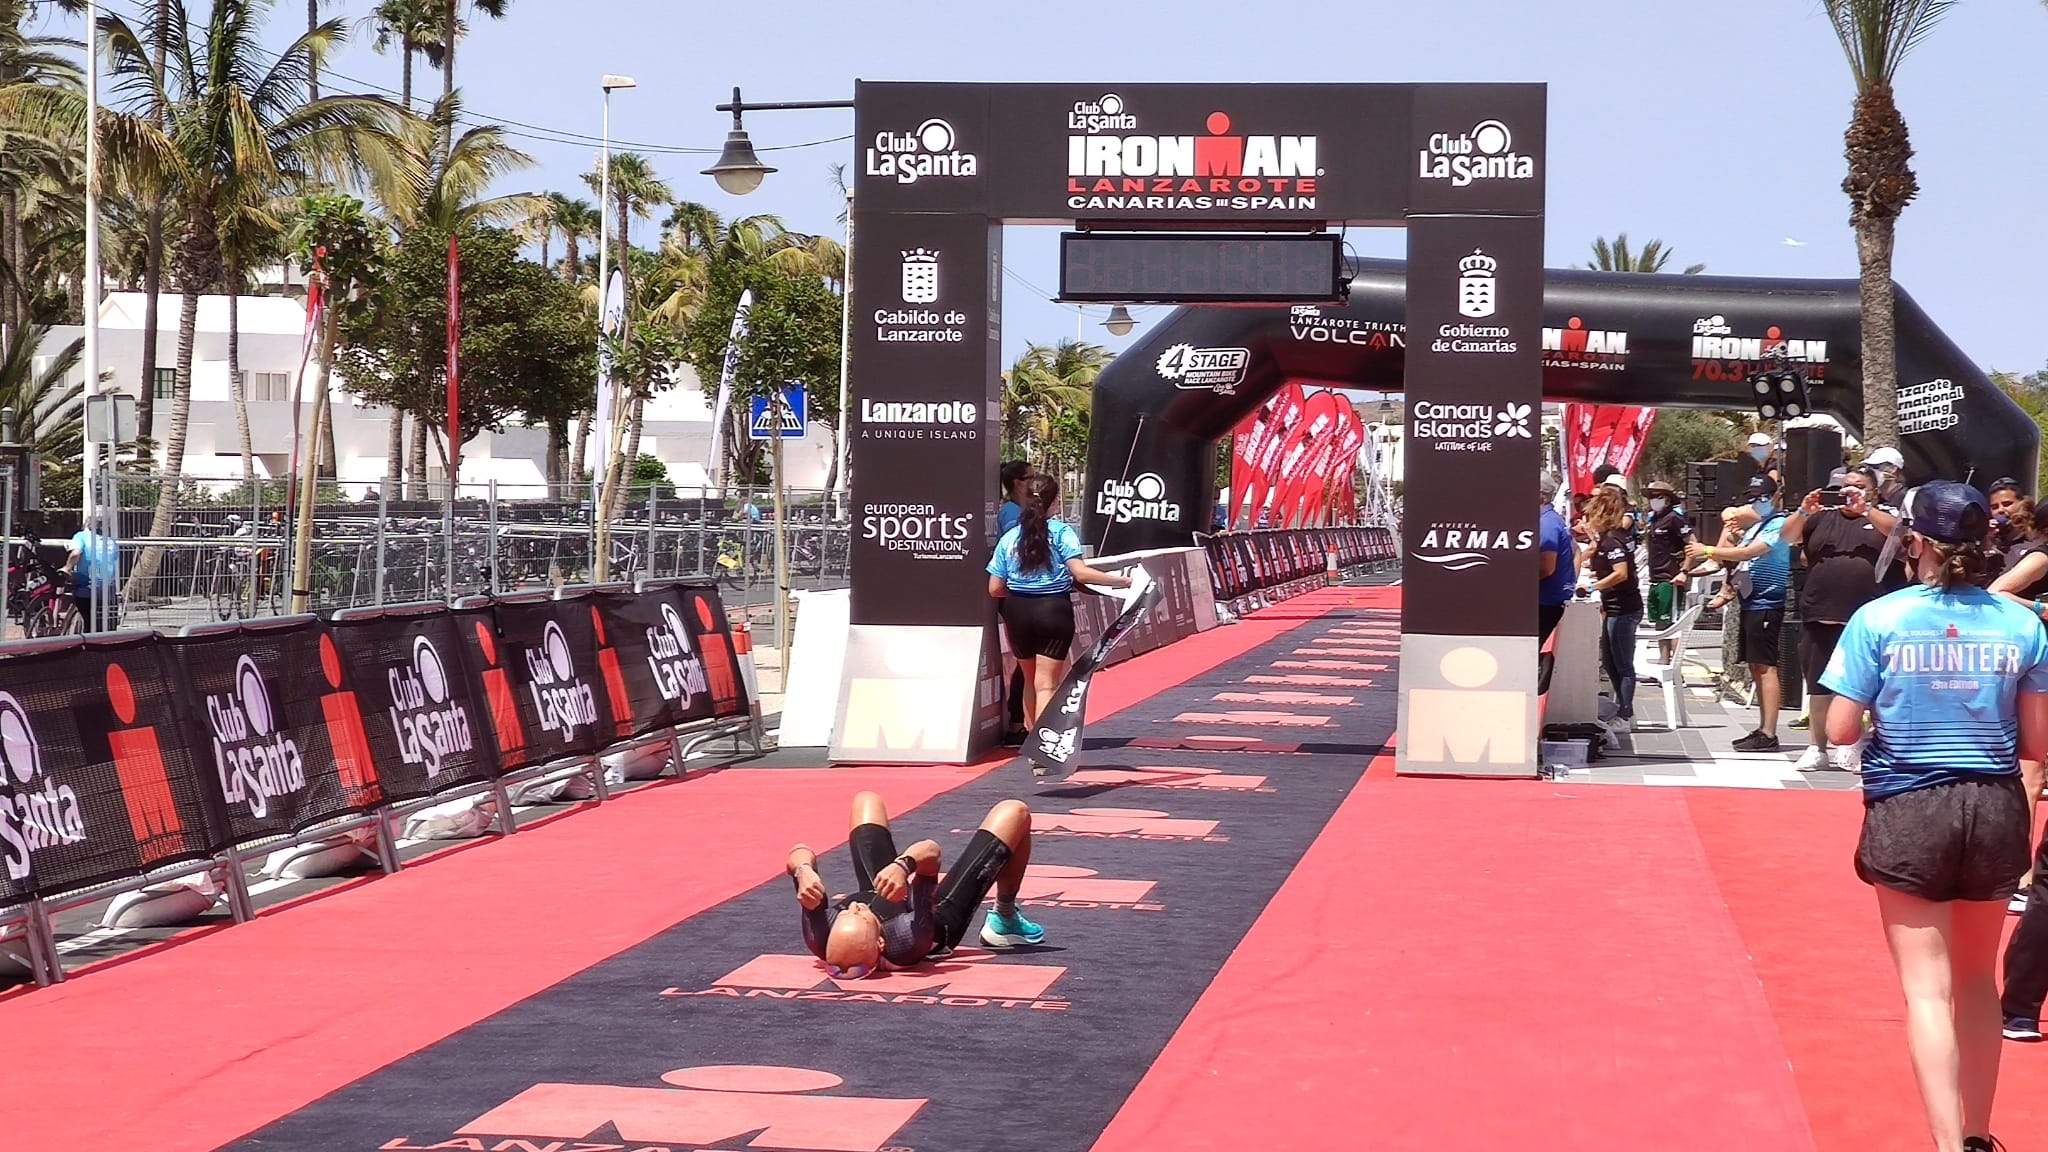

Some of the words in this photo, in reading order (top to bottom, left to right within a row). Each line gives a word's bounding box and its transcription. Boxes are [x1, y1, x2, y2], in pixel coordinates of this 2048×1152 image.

[1074, 101, 1101, 115] Club
[875, 131, 918, 153] Club
[1429, 133, 1473, 154] Club
[1068, 135, 1317, 177] IRONMAN
[1067, 178, 1316, 192] LANZAROTE
[1067, 196, 1212, 209] CANARIAS
[1231, 197, 1316, 210] SPAIN
[874, 309, 940, 325] Cabildo
[944, 310, 966, 325] de
[1290, 316, 1360, 329] LANZAROTE
[1364, 321, 1407, 333] TRIATH
[876, 326, 963, 342] Lanzarote
[1439, 324, 1510, 338] Gobierno
[1431, 339, 1450, 353] de
[1451, 339, 1517, 353] Canarias
[1166, 348, 1185, 373] 4
[1189, 353, 1240, 368] STAGE
[1579, 362, 1625, 371] SPAIN
[1186, 370, 1221, 378] MOUNTAIN
[1691, 360, 1745, 382] 70.3
[861, 398, 977, 424] Lanzarote
[1414, 400, 1493, 424] Canary
[861, 430, 869, 438] A
[874, 430, 924, 439] UNIQUE
[929, 430, 977, 439] ISLAND
[1414, 420, 1492, 438] Islands
[1435, 441, 1467, 451] LATITUDE
[1477, 441, 1492, 452] LIFE
[1103, 479, 1135, 499] Club
[864, 503, 935, 518] european
[862, 512, 969, 546] sports
[888, 539, 962, 551] DESTINATION
[1420, 530, 1535, 550] ARMAS
[647, 623, 679, 660] Club
[525, 648, 554, 684] Club
[1885, 642, 2020, 674] VOLUNTEER
[388, 665, 424, 711] Club
[206, 692, 247, 744] Club
[658, 987, 1072, 1010] LANZAROTE
